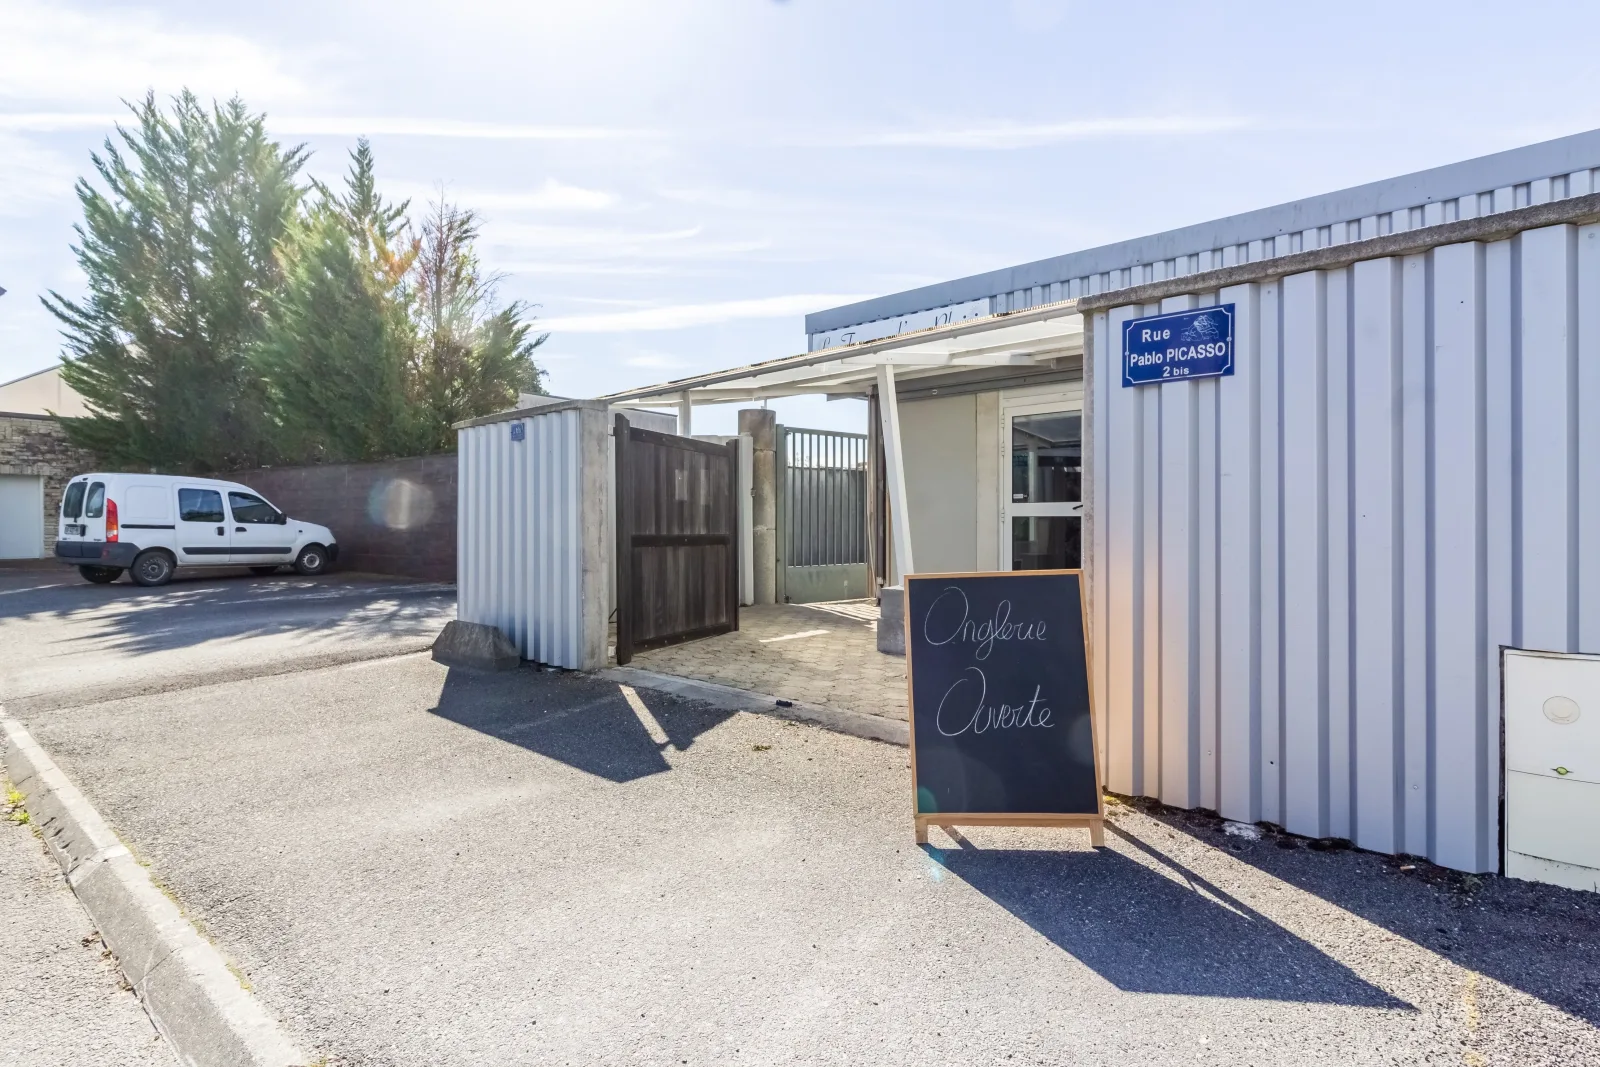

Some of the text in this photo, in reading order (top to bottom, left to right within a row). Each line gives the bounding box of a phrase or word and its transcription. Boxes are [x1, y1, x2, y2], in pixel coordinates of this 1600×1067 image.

[1142, 329, 1171, 342] Rue
[1130, 342, 1226, 367] Pablo PICASSO
[1162, 366, 1190, 377] 2 bis
[924, 586, 1047, 661] Onglerie
[936, 666, 1056, 737] Ouverte
